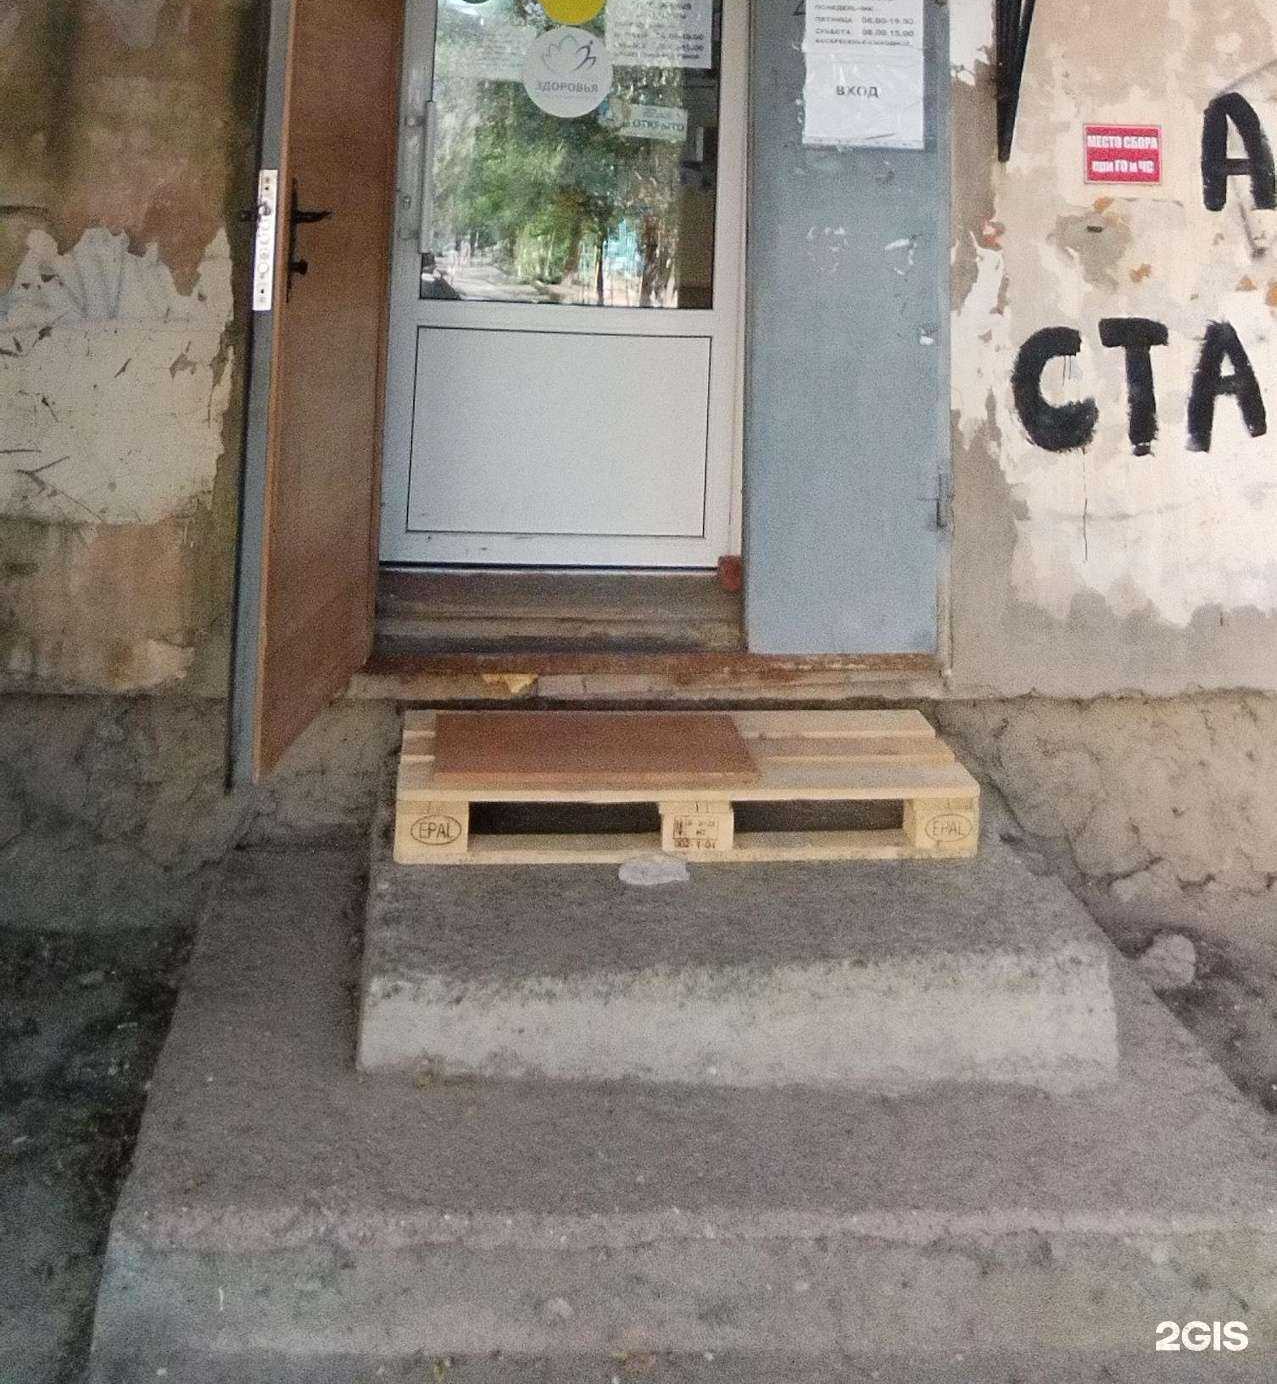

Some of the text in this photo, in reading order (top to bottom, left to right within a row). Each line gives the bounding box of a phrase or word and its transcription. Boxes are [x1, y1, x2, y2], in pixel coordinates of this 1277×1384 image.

[835, 83, 880, 99] ВХОД
[1087, 135, 1158, 150] МЕСТО СБОРА
[1011, 317, 1268, 457] СТА
[417, 821, 456, 840] EPAL
[932, 820, 966, 837] EPAL
